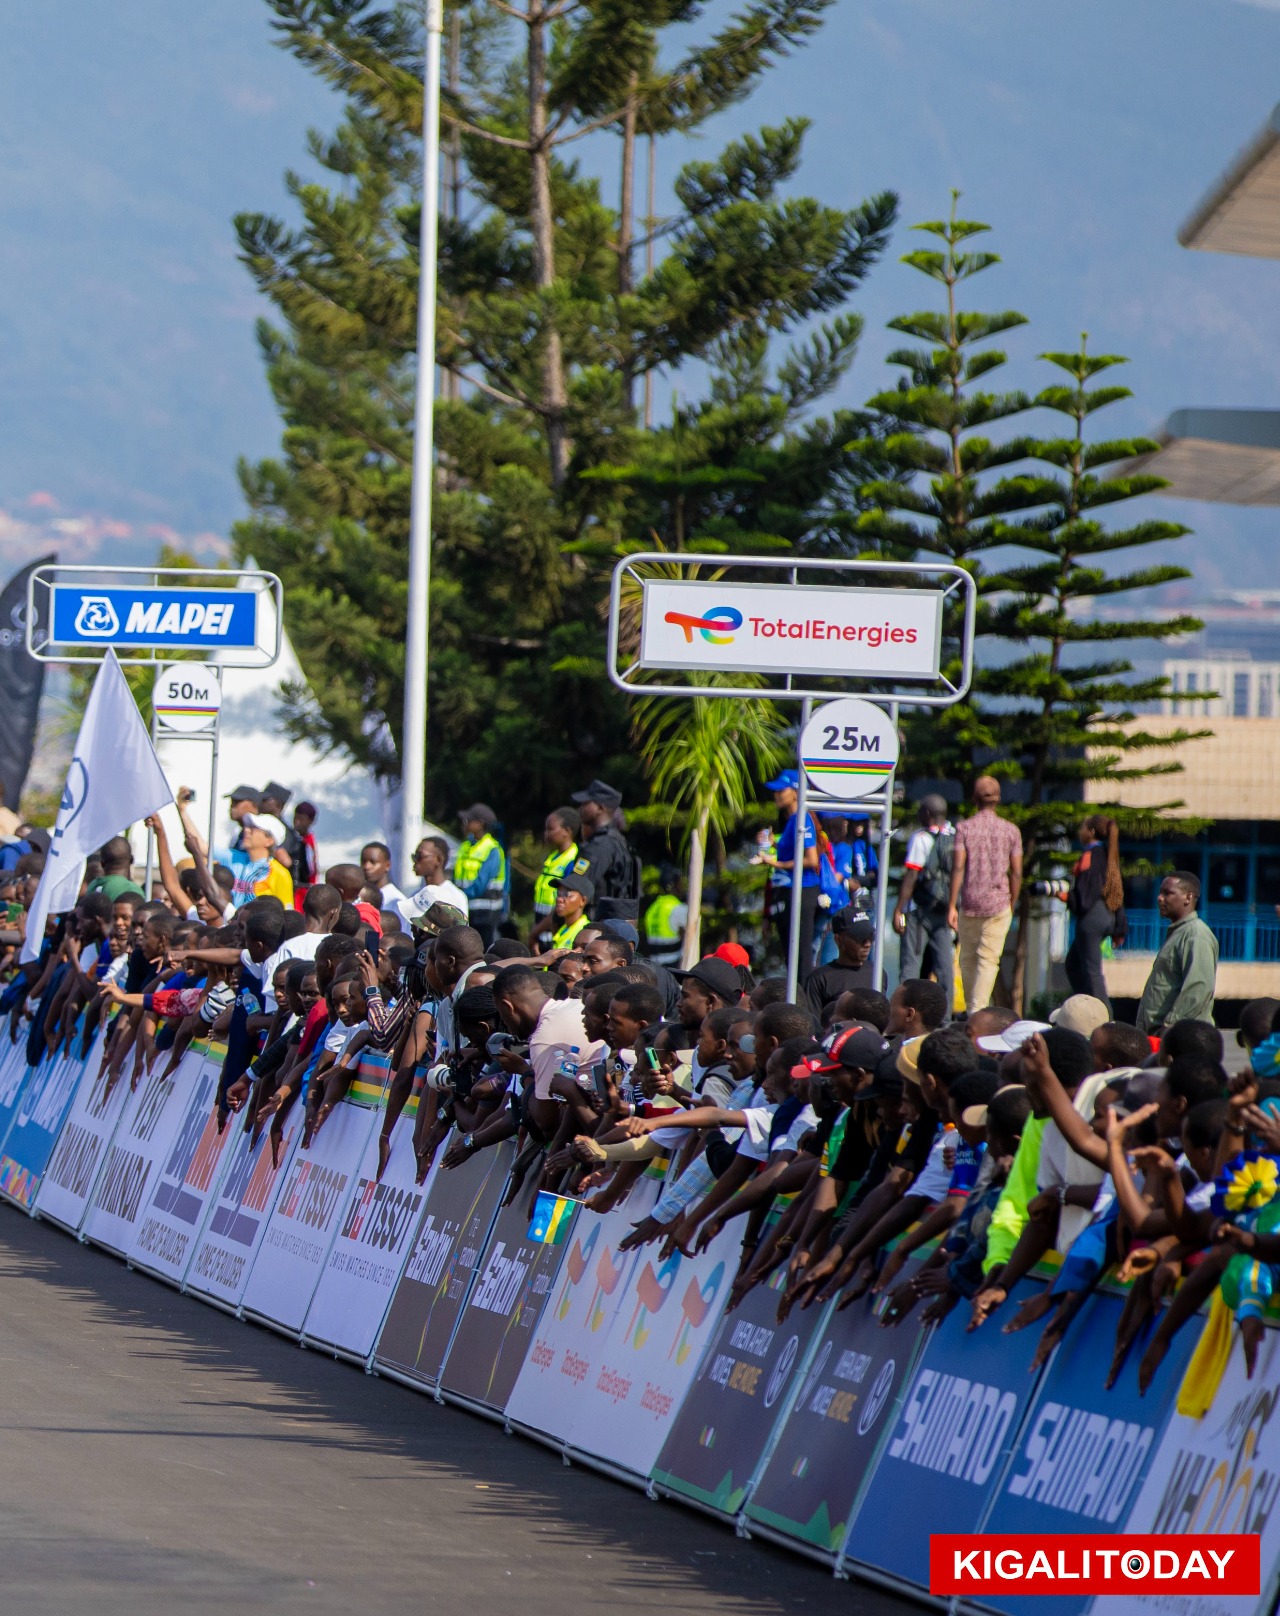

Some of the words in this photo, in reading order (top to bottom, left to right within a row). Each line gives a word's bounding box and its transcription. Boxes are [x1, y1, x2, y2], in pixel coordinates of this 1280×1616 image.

[125, 602, 235, 636] MAPEI
[748, 617, 918, 647] TotalEnergies
[168, 682, 209, 701] 50M
[822, 725, 881, 752] 25M
[129, 1074, 176, 1142] VISIT
[95, 1145, 153, 1224] RWANDA
[296, 1168, 349, 1232] TISSOT
[361, 1185, 423, 1254] TISSOT
[888, 1368, 1018, 1486] SHIMANO
[1007, 1401, 1155, 1524] SHIMANO
